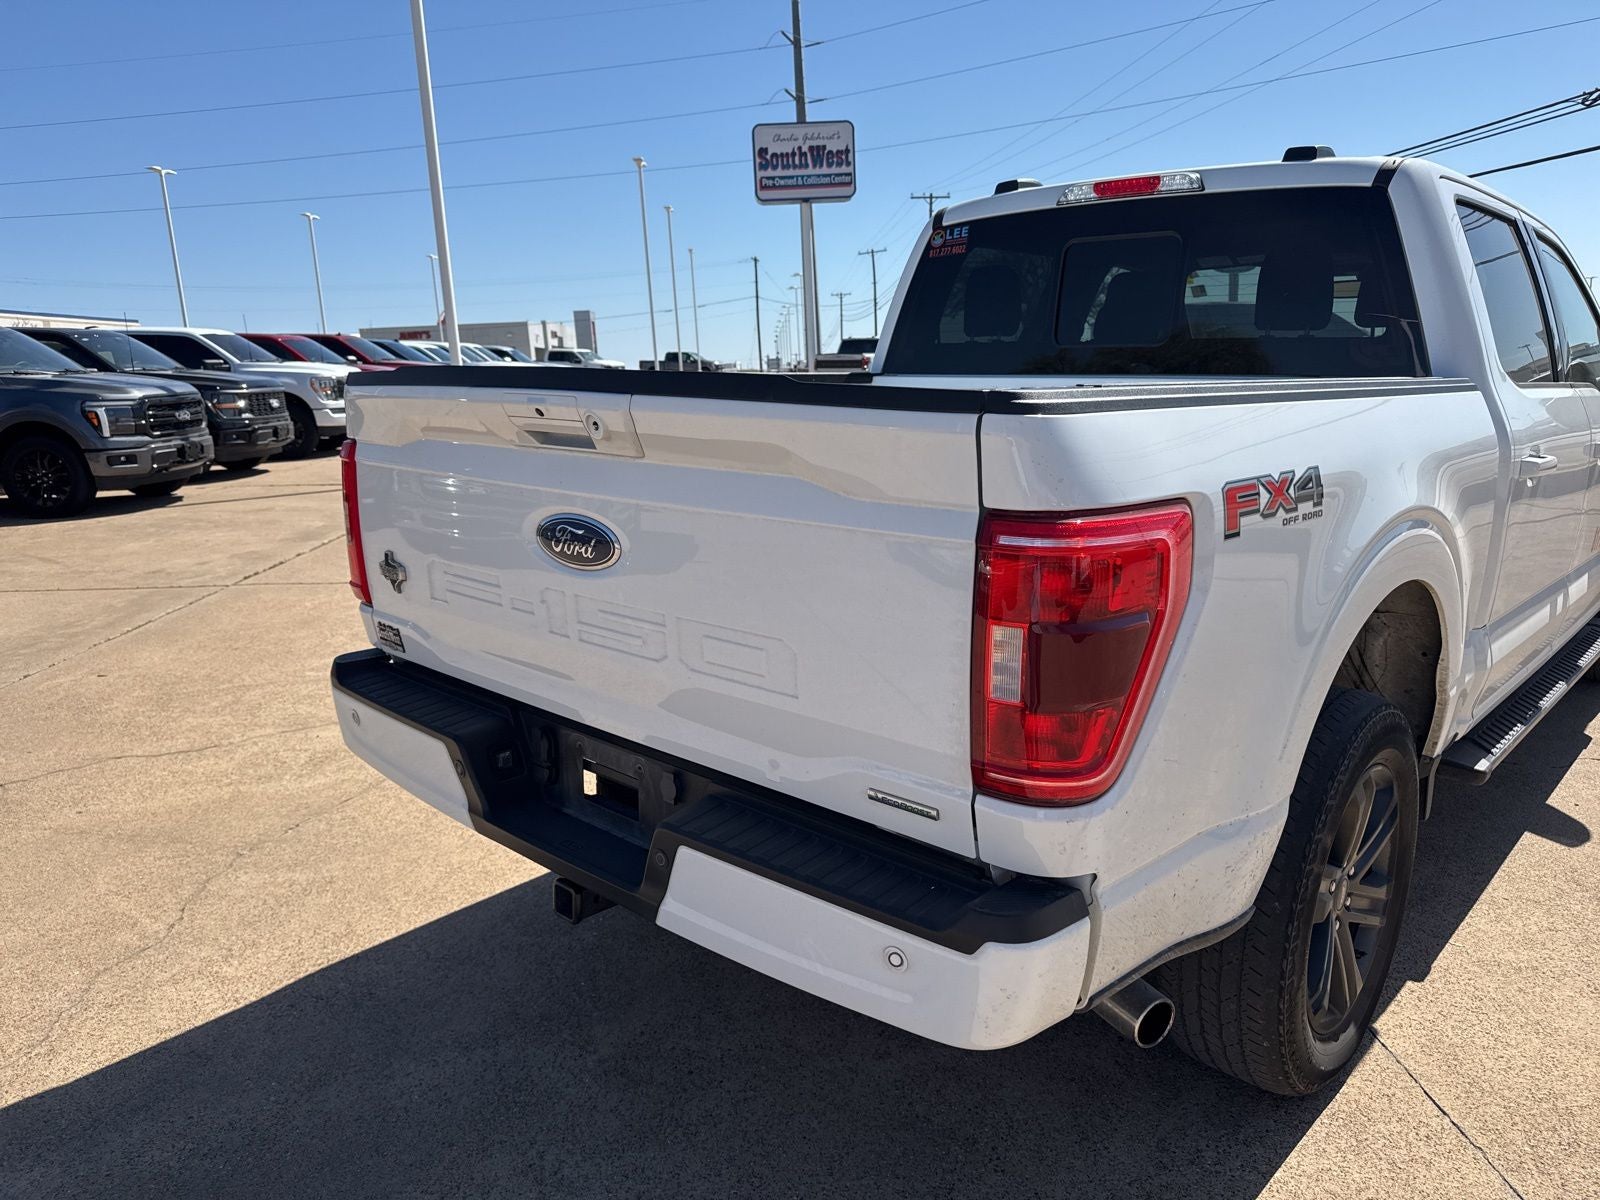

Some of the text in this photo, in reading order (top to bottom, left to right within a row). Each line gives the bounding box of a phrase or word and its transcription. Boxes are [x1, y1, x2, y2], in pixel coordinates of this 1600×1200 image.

[772, 133, 799, 144] Charlie
[762, 174, 852, 187] Pre-Owned & Collision Center
[945, 226, 969, 240] LEE
[1221, 465, 1323, 541] FX4
[1282, 509, 1323, 526] OFF ROAD
[551, 524, 596, 559] Ford
[427, 558, 799, 700] F-150
